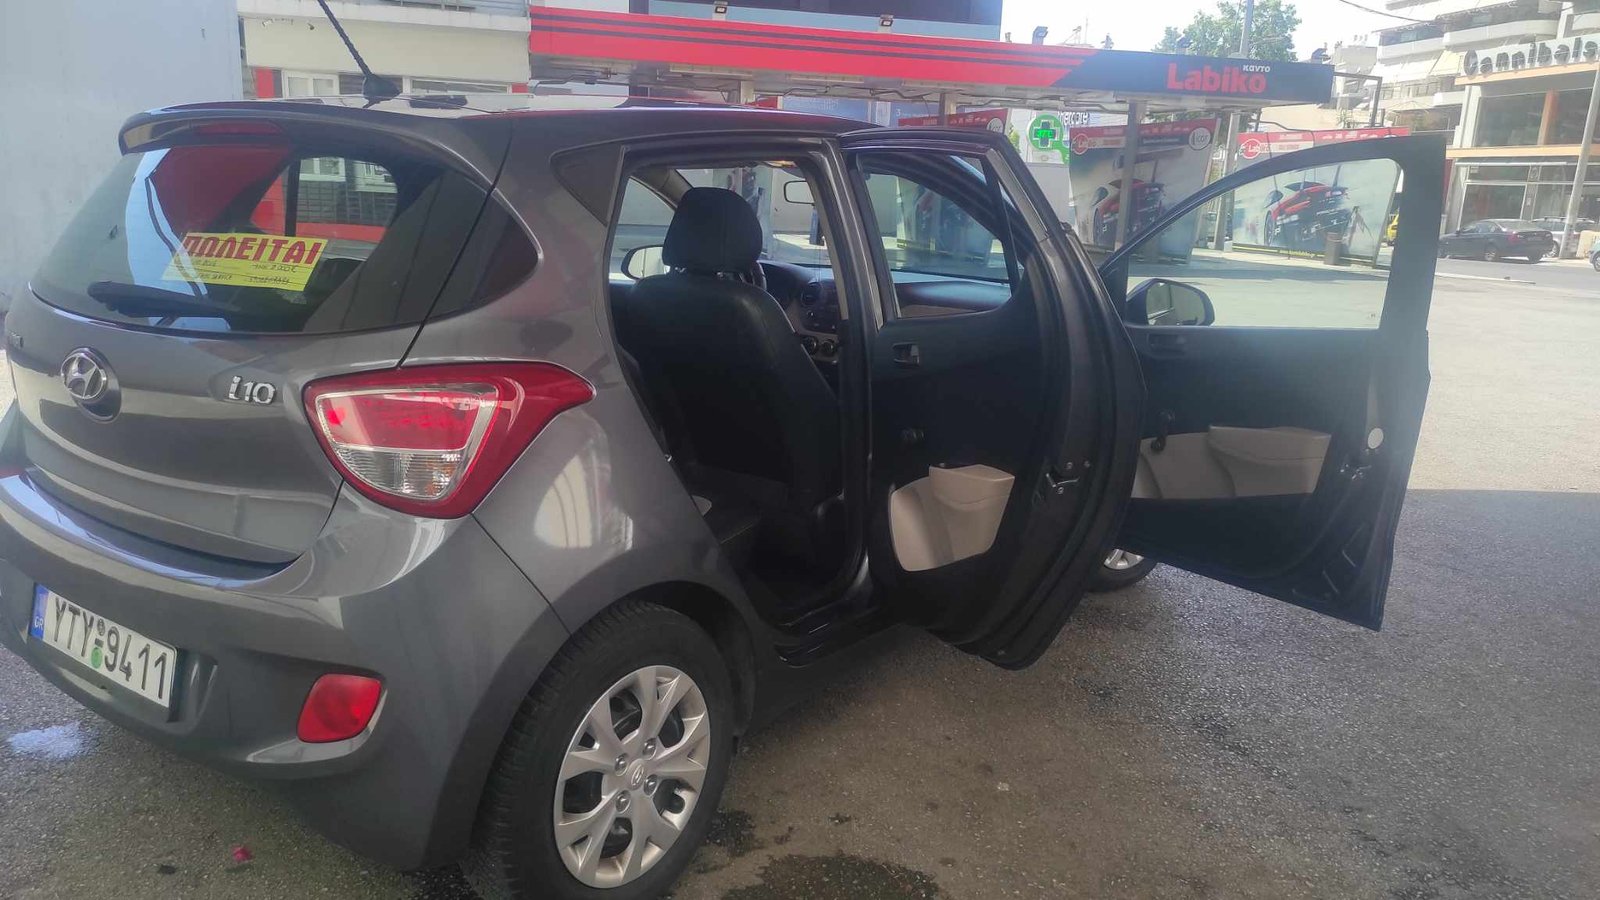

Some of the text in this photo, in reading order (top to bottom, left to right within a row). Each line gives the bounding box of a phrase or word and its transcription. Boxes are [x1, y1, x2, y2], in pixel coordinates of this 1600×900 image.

[1463, 37, 1599, 76] Cannibals
[1167, 62, 1266, 94] Labiko
[183, 235, 322, 265] ΠΩΛΕΙΤΑΙ
[228, 375, 276, 404] i10
[34, 616, 44, 630] GR
